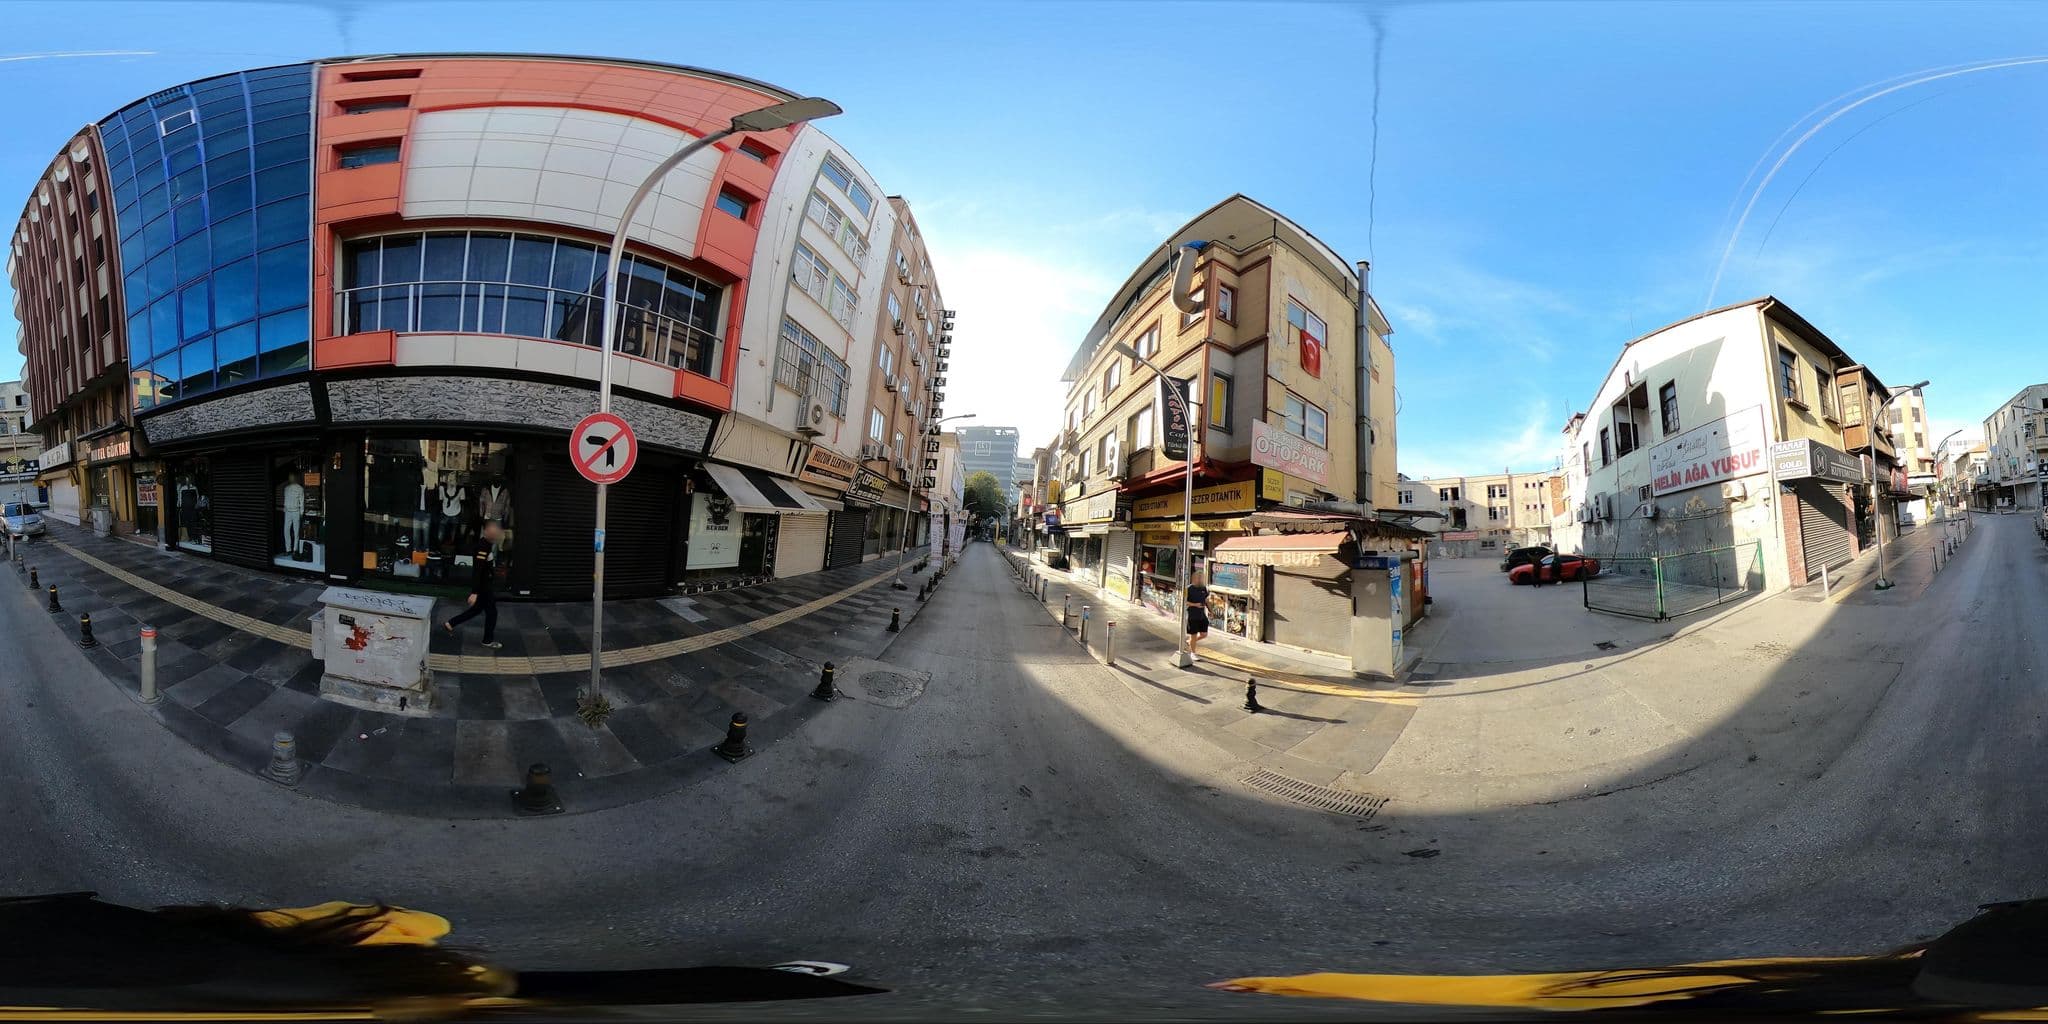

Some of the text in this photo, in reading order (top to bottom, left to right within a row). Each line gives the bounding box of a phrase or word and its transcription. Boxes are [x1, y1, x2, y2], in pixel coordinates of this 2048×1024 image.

[937, 311, 955, 372] HOTEL
[925, 392, 944, 488] SAVRAN
[1256, 436, 1325, 475] OTOPARK
[1654, 469, 1682, 492] HELİN
[1685, 462, 1710, 484] AĞA
[1712, 449, 1760, 477] YUSUF
[1780, 461, 1802, 470] GOLD
[1191, 488, 1242, 504] SEZER OTANTİK
